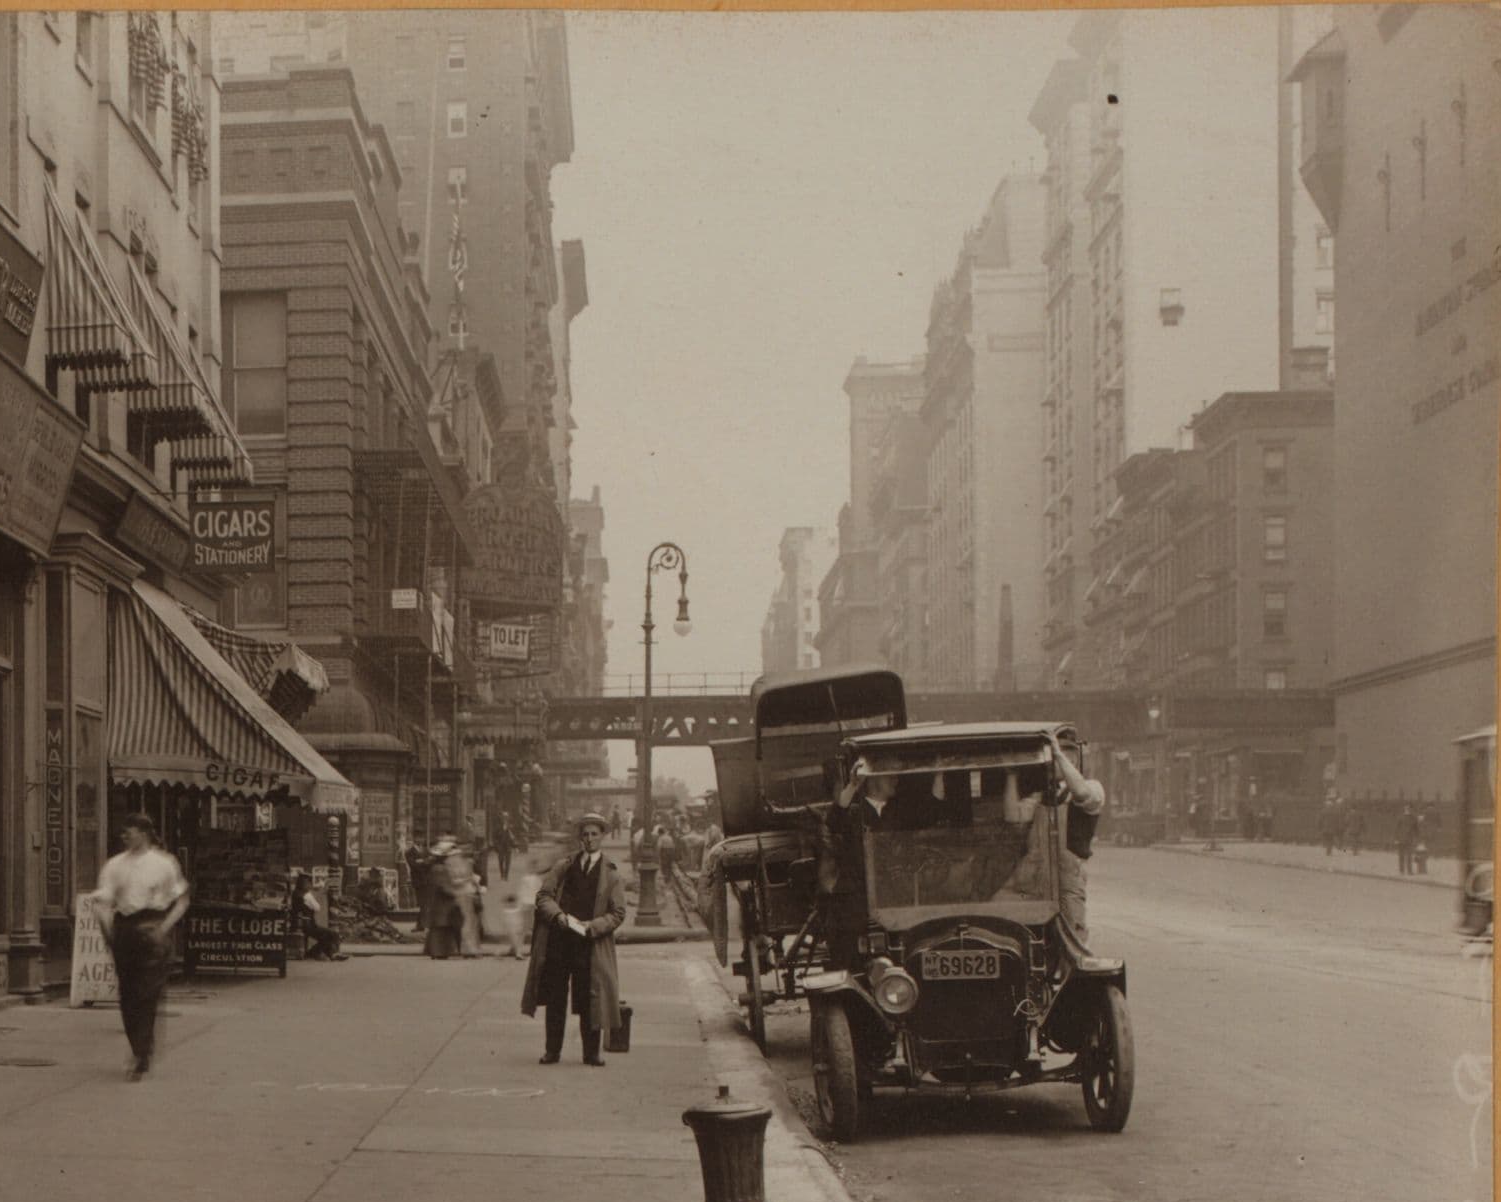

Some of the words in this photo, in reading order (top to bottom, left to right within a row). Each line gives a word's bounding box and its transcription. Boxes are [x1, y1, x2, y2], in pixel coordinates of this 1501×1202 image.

[193, 510, 271, 538] CIGARS
[194, 540, 271, 566] STATIONERY
[494, 628, 507, 643] TO
[509, 630, 527, 646] LET
[48, 729, 62, 885] MAGNETOS
[189, 919, 223, 934] THE
[254, 941, 284, 950] CLASS
[939, 955, 997, 977] 69628
